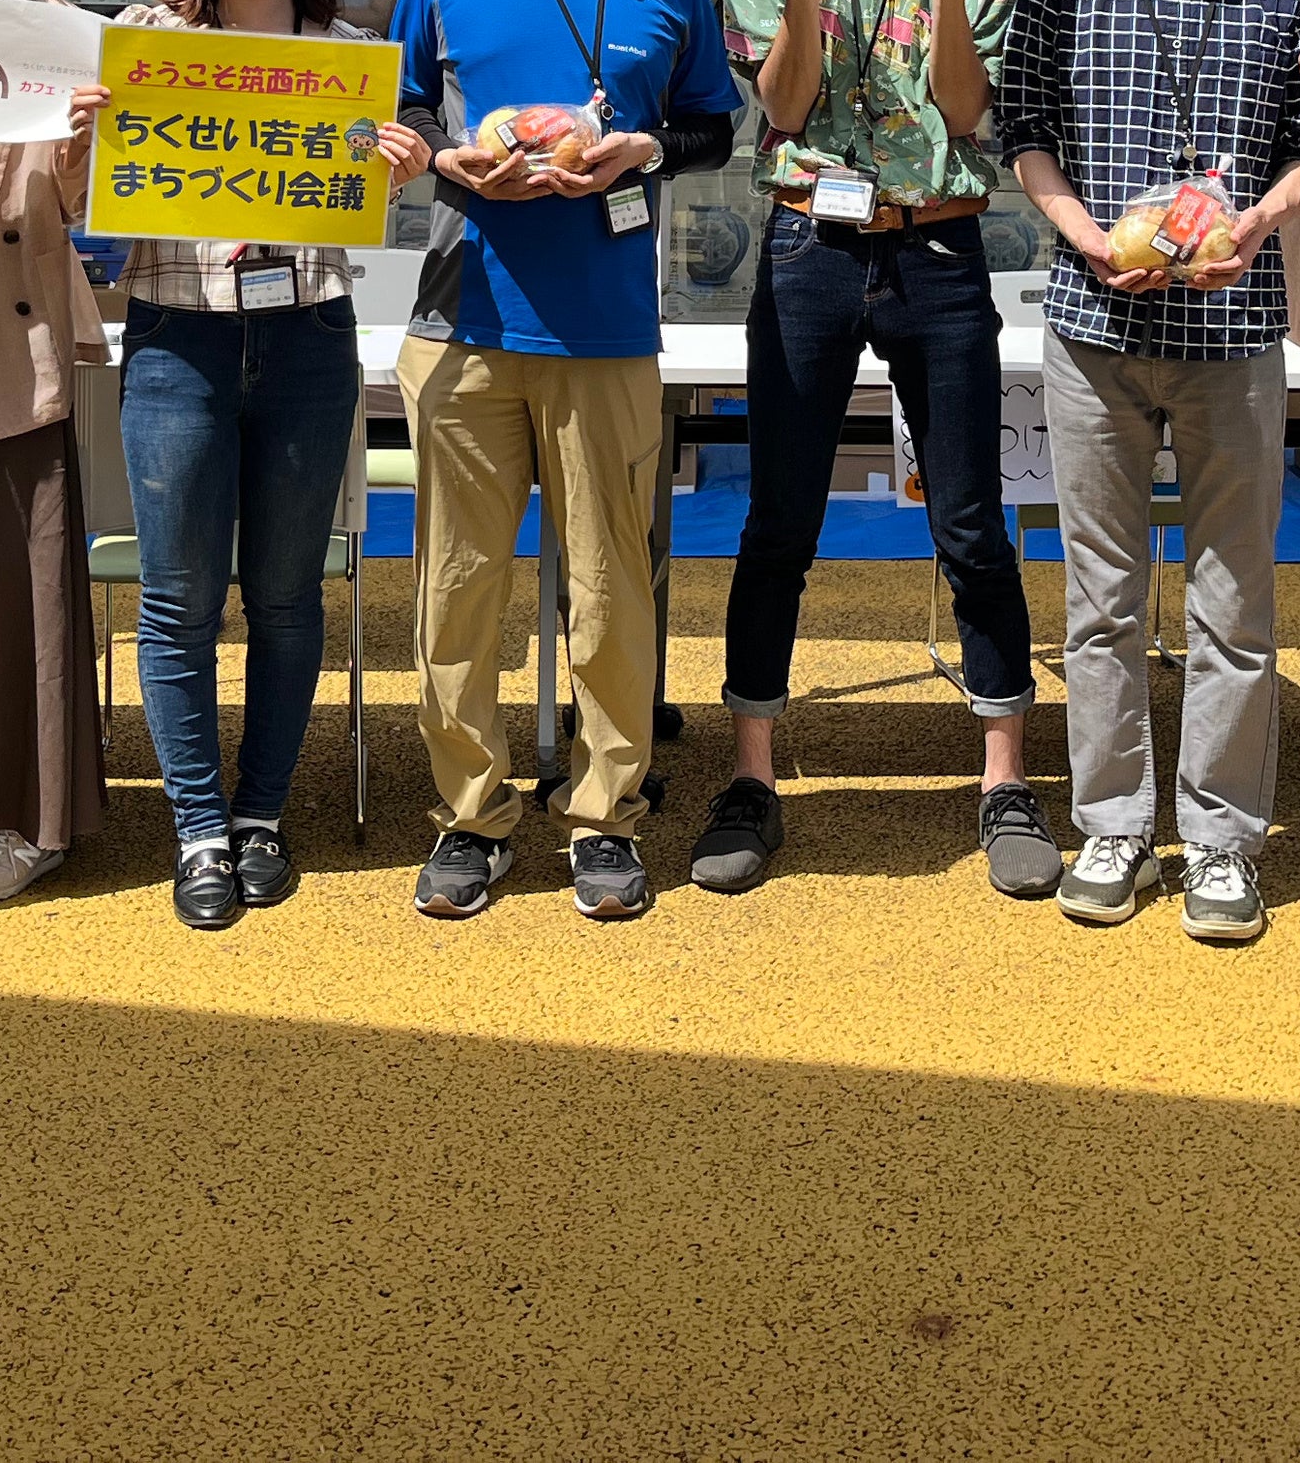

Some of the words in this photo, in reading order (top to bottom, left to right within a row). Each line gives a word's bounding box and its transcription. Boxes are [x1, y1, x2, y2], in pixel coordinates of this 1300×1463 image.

[19, 80, 77, 96] カフェ・
[126, 58, 370, 98] ようこそ筑西市へ！
[114, 110, 340, 159] ちくせい若者
[110, 160, 367, 213] まちづくり会議
